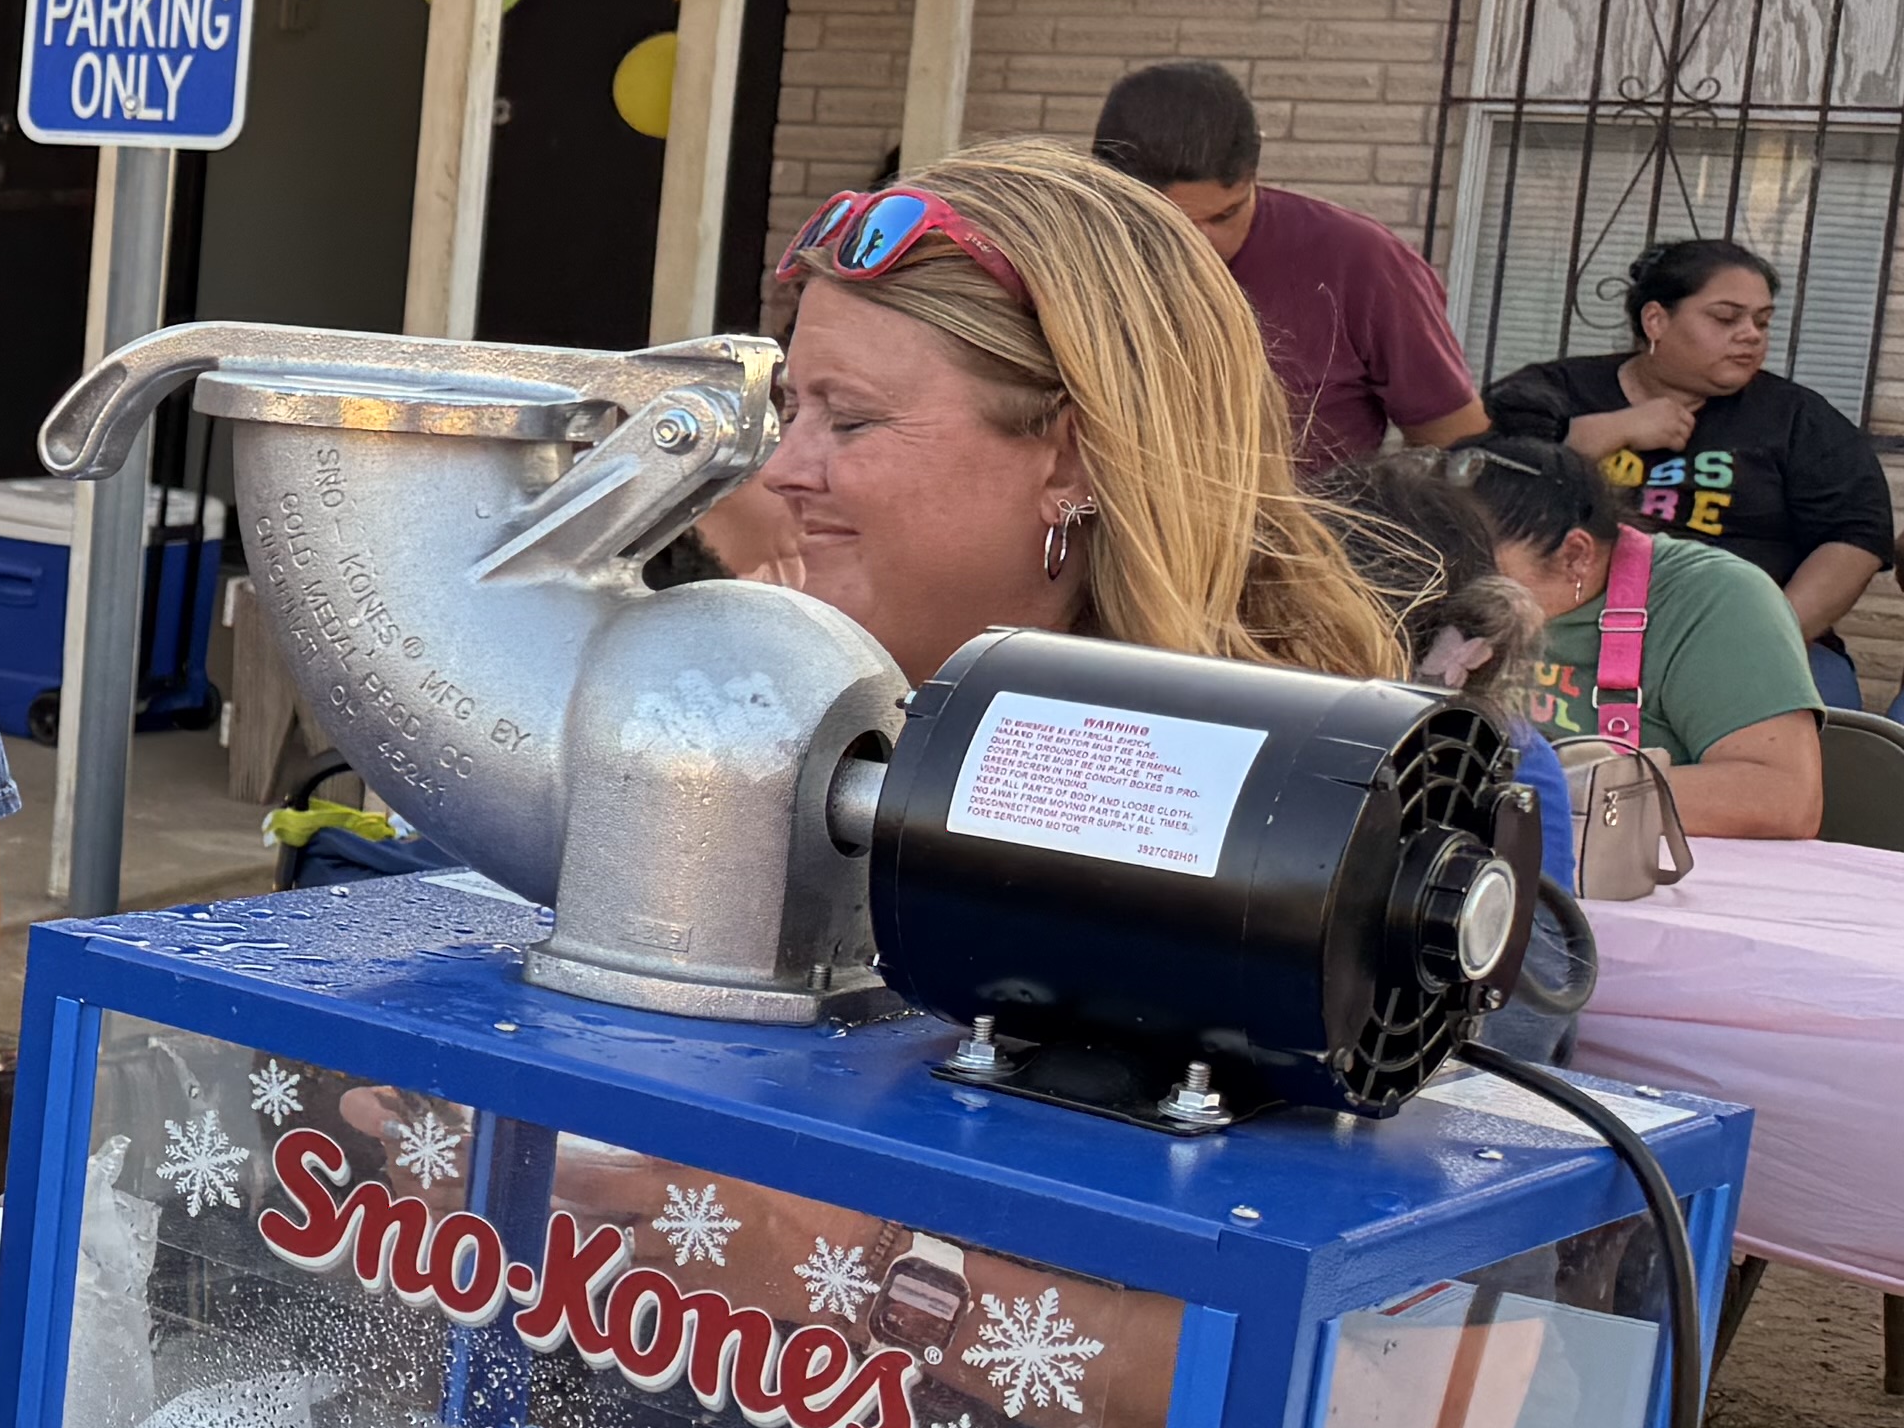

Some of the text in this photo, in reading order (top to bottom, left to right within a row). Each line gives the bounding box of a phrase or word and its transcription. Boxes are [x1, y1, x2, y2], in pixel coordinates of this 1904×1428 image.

[71, 52, 194, 123] ONLY
[301, 579, 358, 673] MEDAL
[419, 669, 476, 720] MFG
[490, 717, 532, 753] BY
[1084, 718, 1150, 736] WARNING
[1000, 717, 1012, 727] TO
[1057, 728, 1113, 742] ELECTRICAL
[1117, 736, 1151, 748] SHOCK
[1037, 733, 1054, 743] THE
[1056, 737, 1089, 749] MOTOR
[1092, 742, 1118, 753] MUST
[1120, 747, 1134, 756] BE
[987, 745, 1018, 757] COVER
[1020, 751, 1051, 763] PLATE
[1052, 755, 1078, 766] MUST
[1080, 760, 1095, 769] BE
[1096, 763, 1106, 772] IN
[1146, 772, 1164, 781] THE
[991, 736, 1182, 775] QUATELY GROUNDED AND THE TERMINAL
[976, 774, 1193, 819] KEEP ALL PARTS OF BODY AND LOOSE CLOTH-
[980, 763, 1089, 790] VIDED FOR GROUNDING.
[983, 755, 1200, 799] GREEN SCREW IN THE CONDUIT BOXES IS PRO-
[967, 806, 992, 818] FORE
[994, 811, 1043, 828] SERVICING
[969, 795, 1154, 836] DISCONNECT FROM POWER SUPPLY BE-
[972, 785, 1190, 831] ING AWAY FROM MOVING PARTS AT ALL TIMES.
